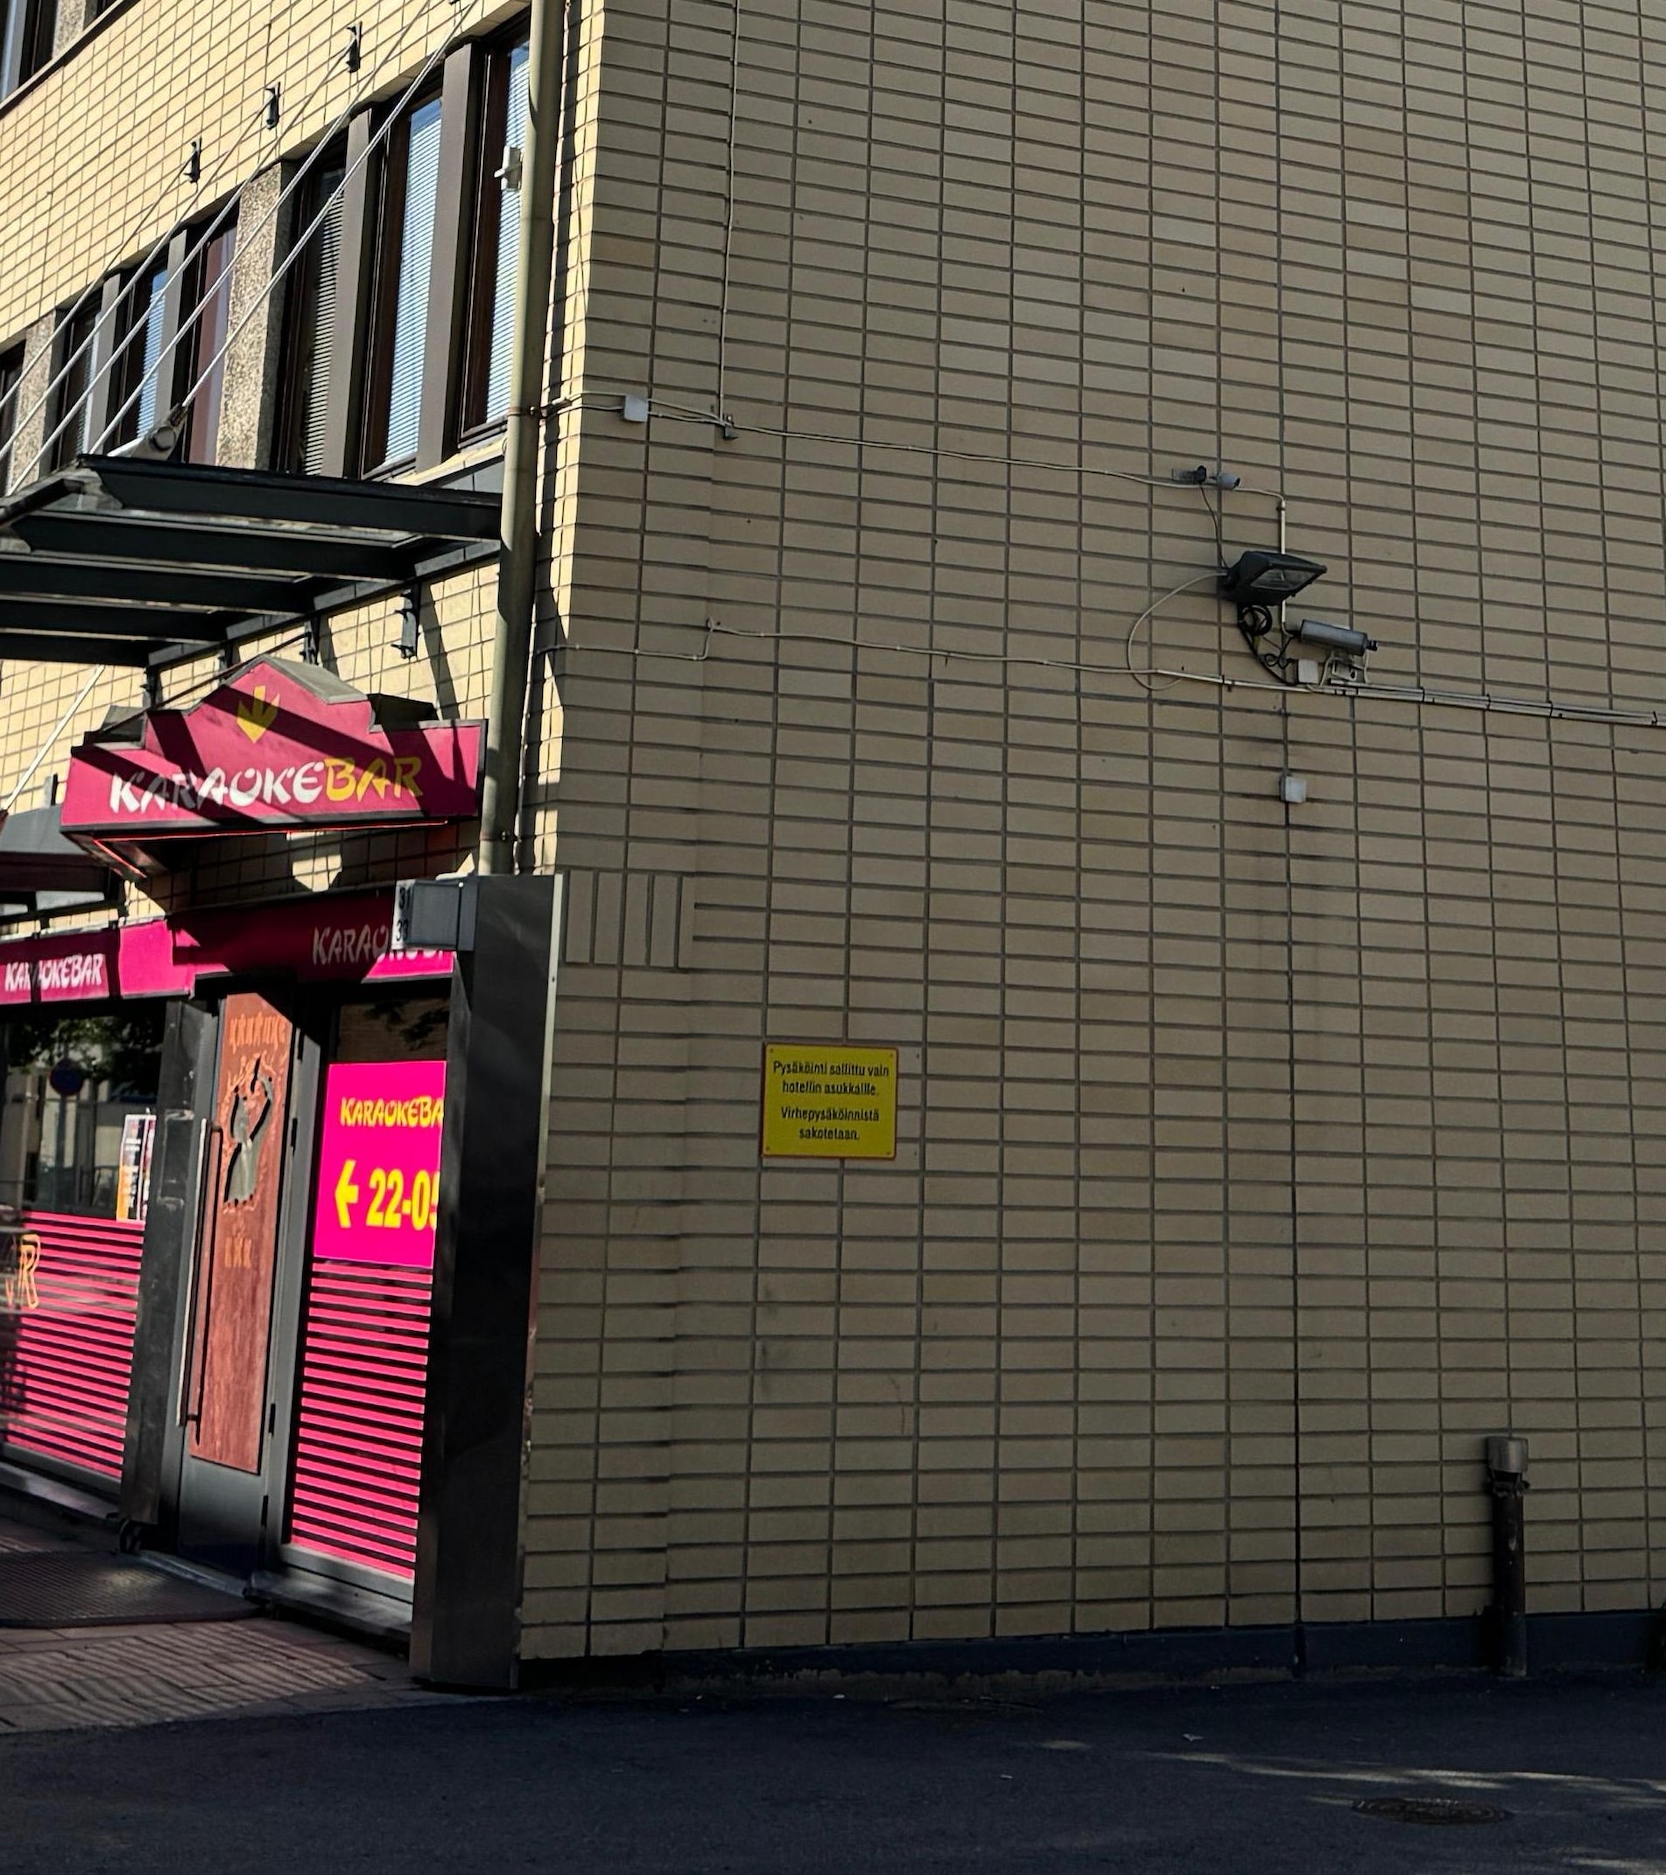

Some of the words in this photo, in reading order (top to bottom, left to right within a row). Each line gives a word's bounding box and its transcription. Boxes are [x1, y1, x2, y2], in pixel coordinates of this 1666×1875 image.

[772, 1059, 828, 1077] Pysäköinti
[829, 1061, 865, 1077] sallittu
[867, 1063, 890, 1078] vain
[782, 1081, 822, 1095] hotellin
[780, 1104, 880, 1123] Virhepysäköinnistä
[798, 1126, 860, 1141] sakotetaan.
